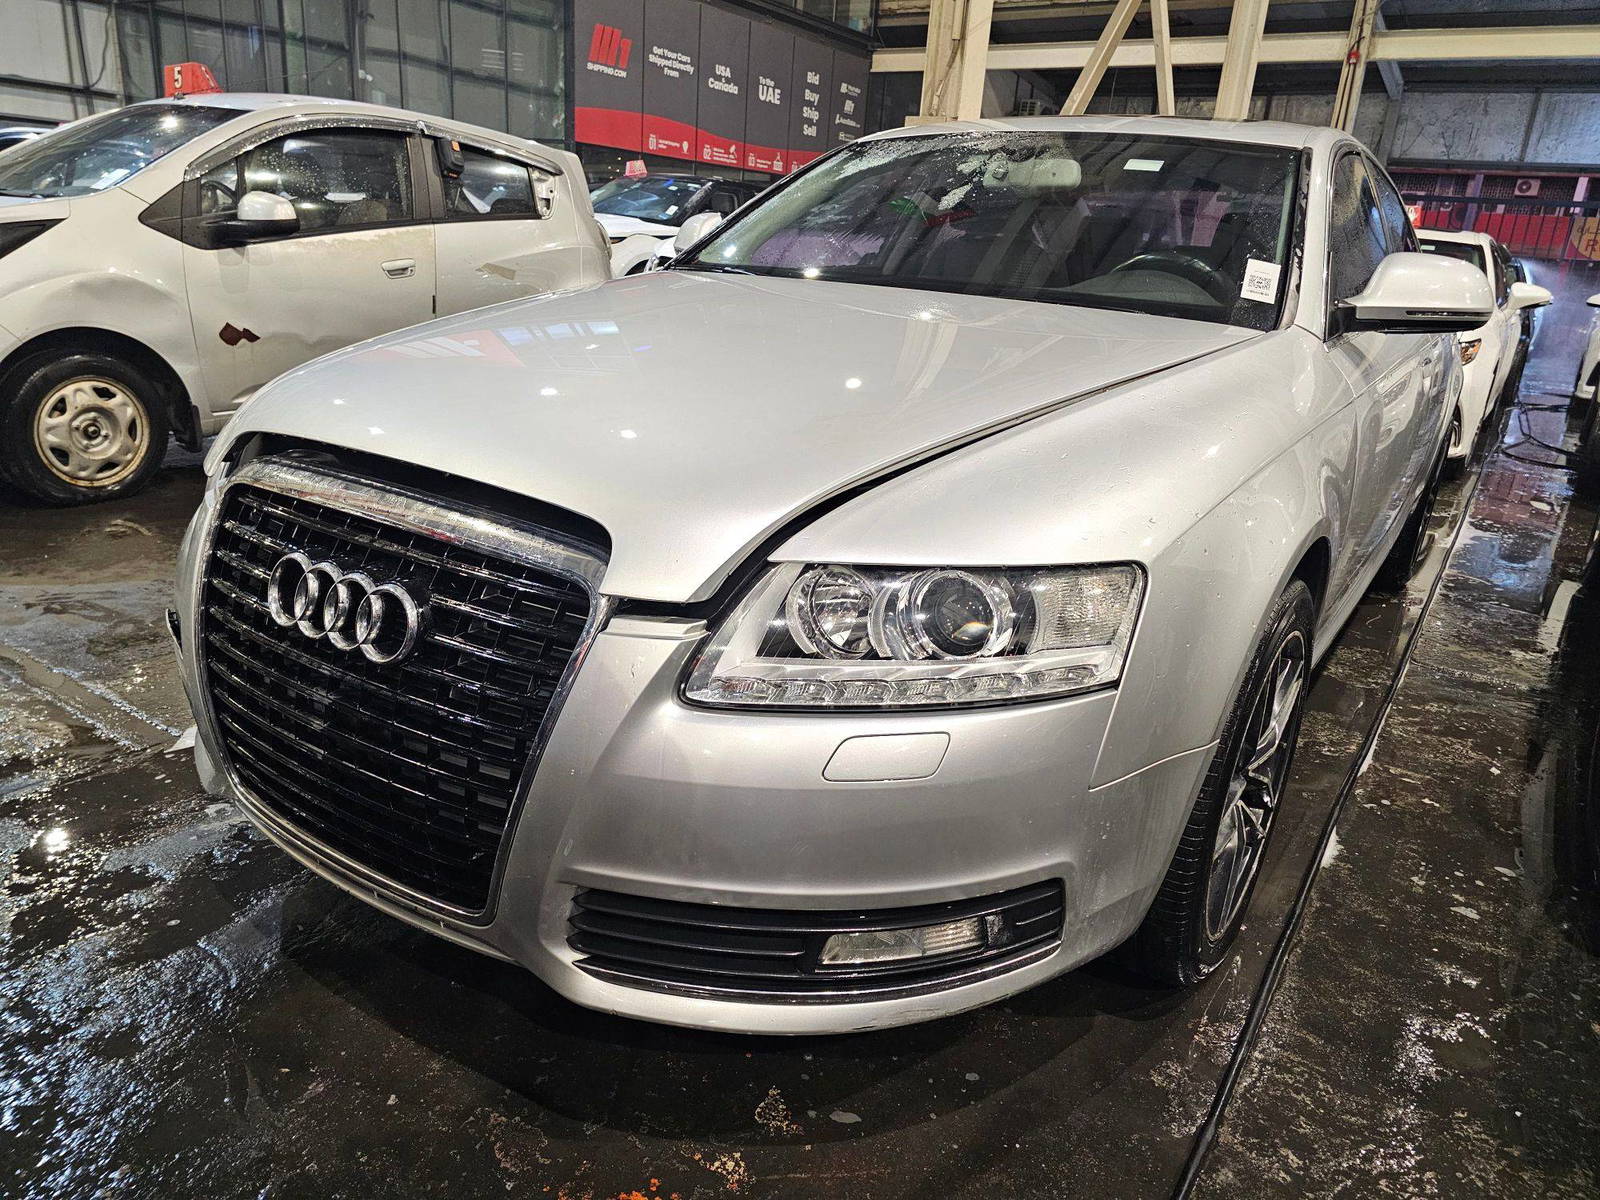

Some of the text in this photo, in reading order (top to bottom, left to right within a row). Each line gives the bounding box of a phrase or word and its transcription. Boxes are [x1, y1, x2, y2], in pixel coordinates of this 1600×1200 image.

[652, 45, 691, 63] Get Your Cars
[586, 62, 627, 78] SHIPPING.COM
[648, 53, 695, 75] Shipped Directly
[664, 67, 680, 78] From
[715, 64, 731, 78] USA
[174, 66, 182, 88] 5
[759, 76, 775, 87] To the
[807, 71, 820, 85] Bid
[708, 77, 738, 95] Canada
[758, 84, 781, 104] UAE
[804, 88, 820, 106] Buy
[802, 106, 819, 123] Ship
[802, 124, 817, 137] Sell
